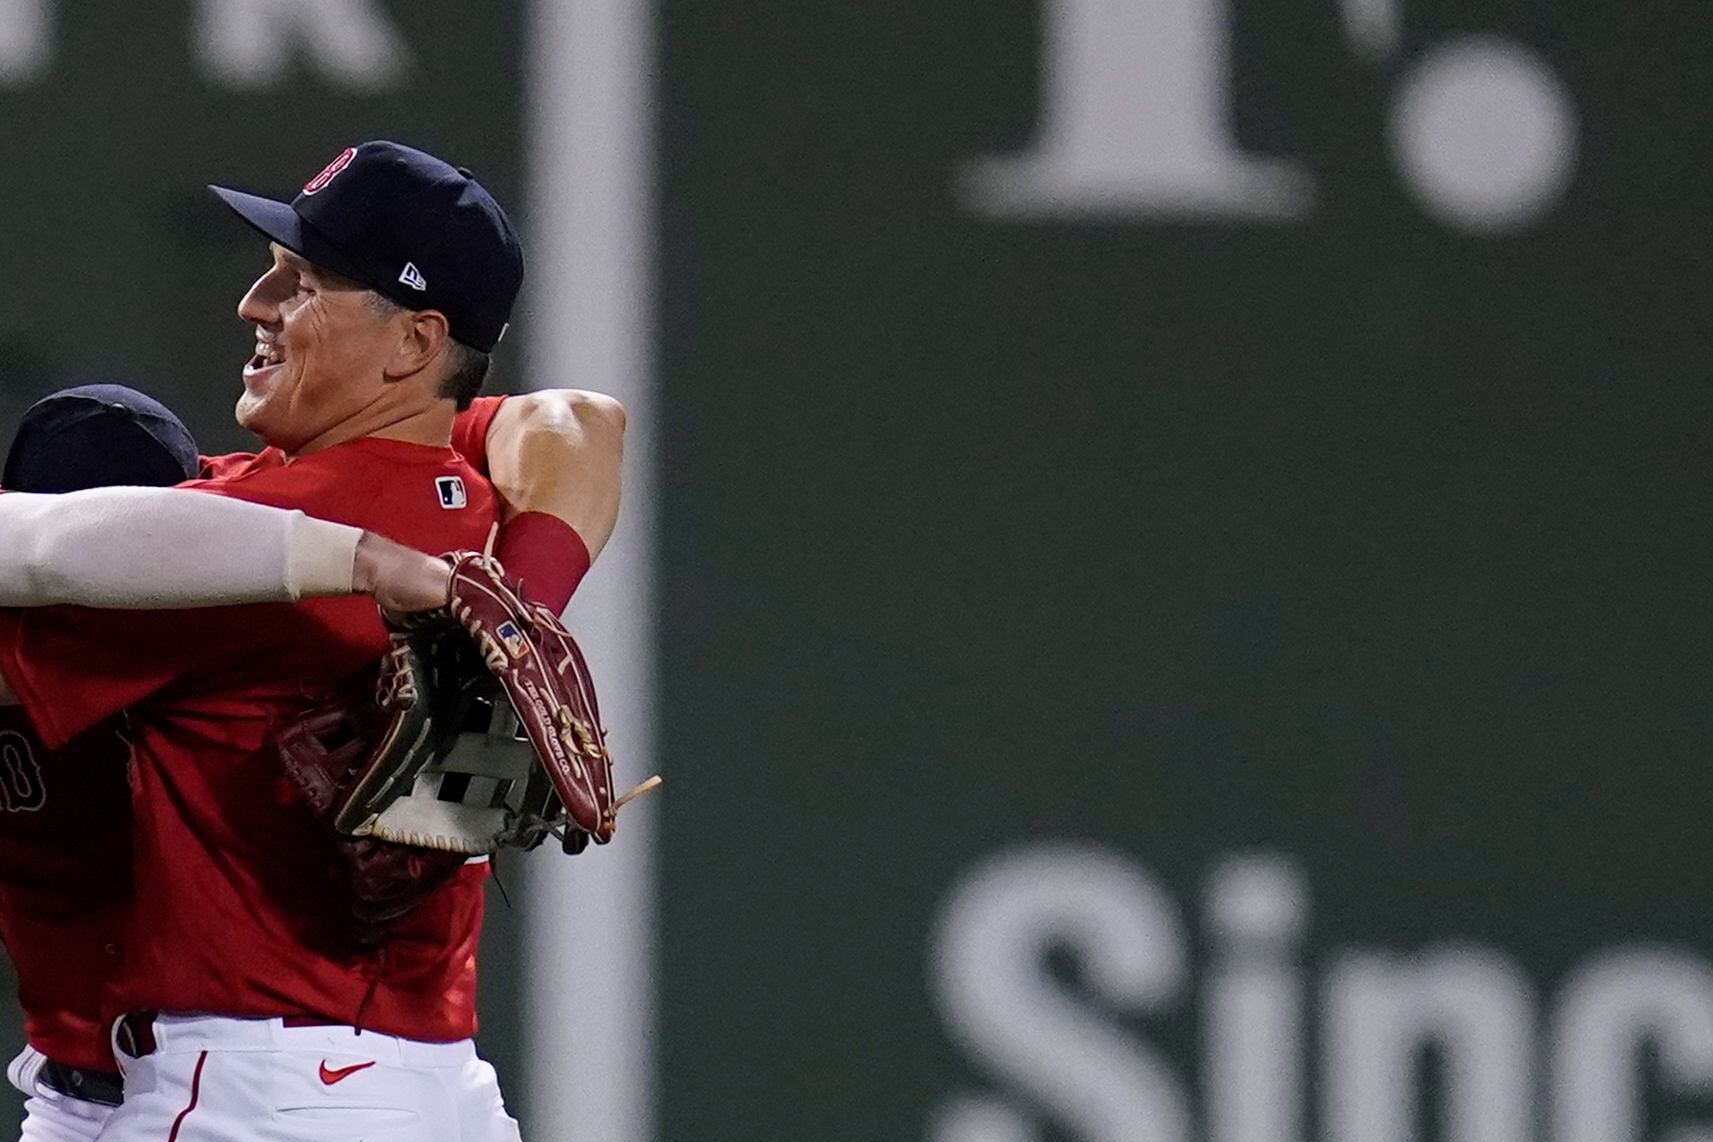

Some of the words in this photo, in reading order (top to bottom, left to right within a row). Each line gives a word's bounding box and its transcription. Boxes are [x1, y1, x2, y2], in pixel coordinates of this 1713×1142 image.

[302, 147, 357, 196] B
[535, 698, 551, 727] GOLD
[547, 725, 566, 759] GLOVE
